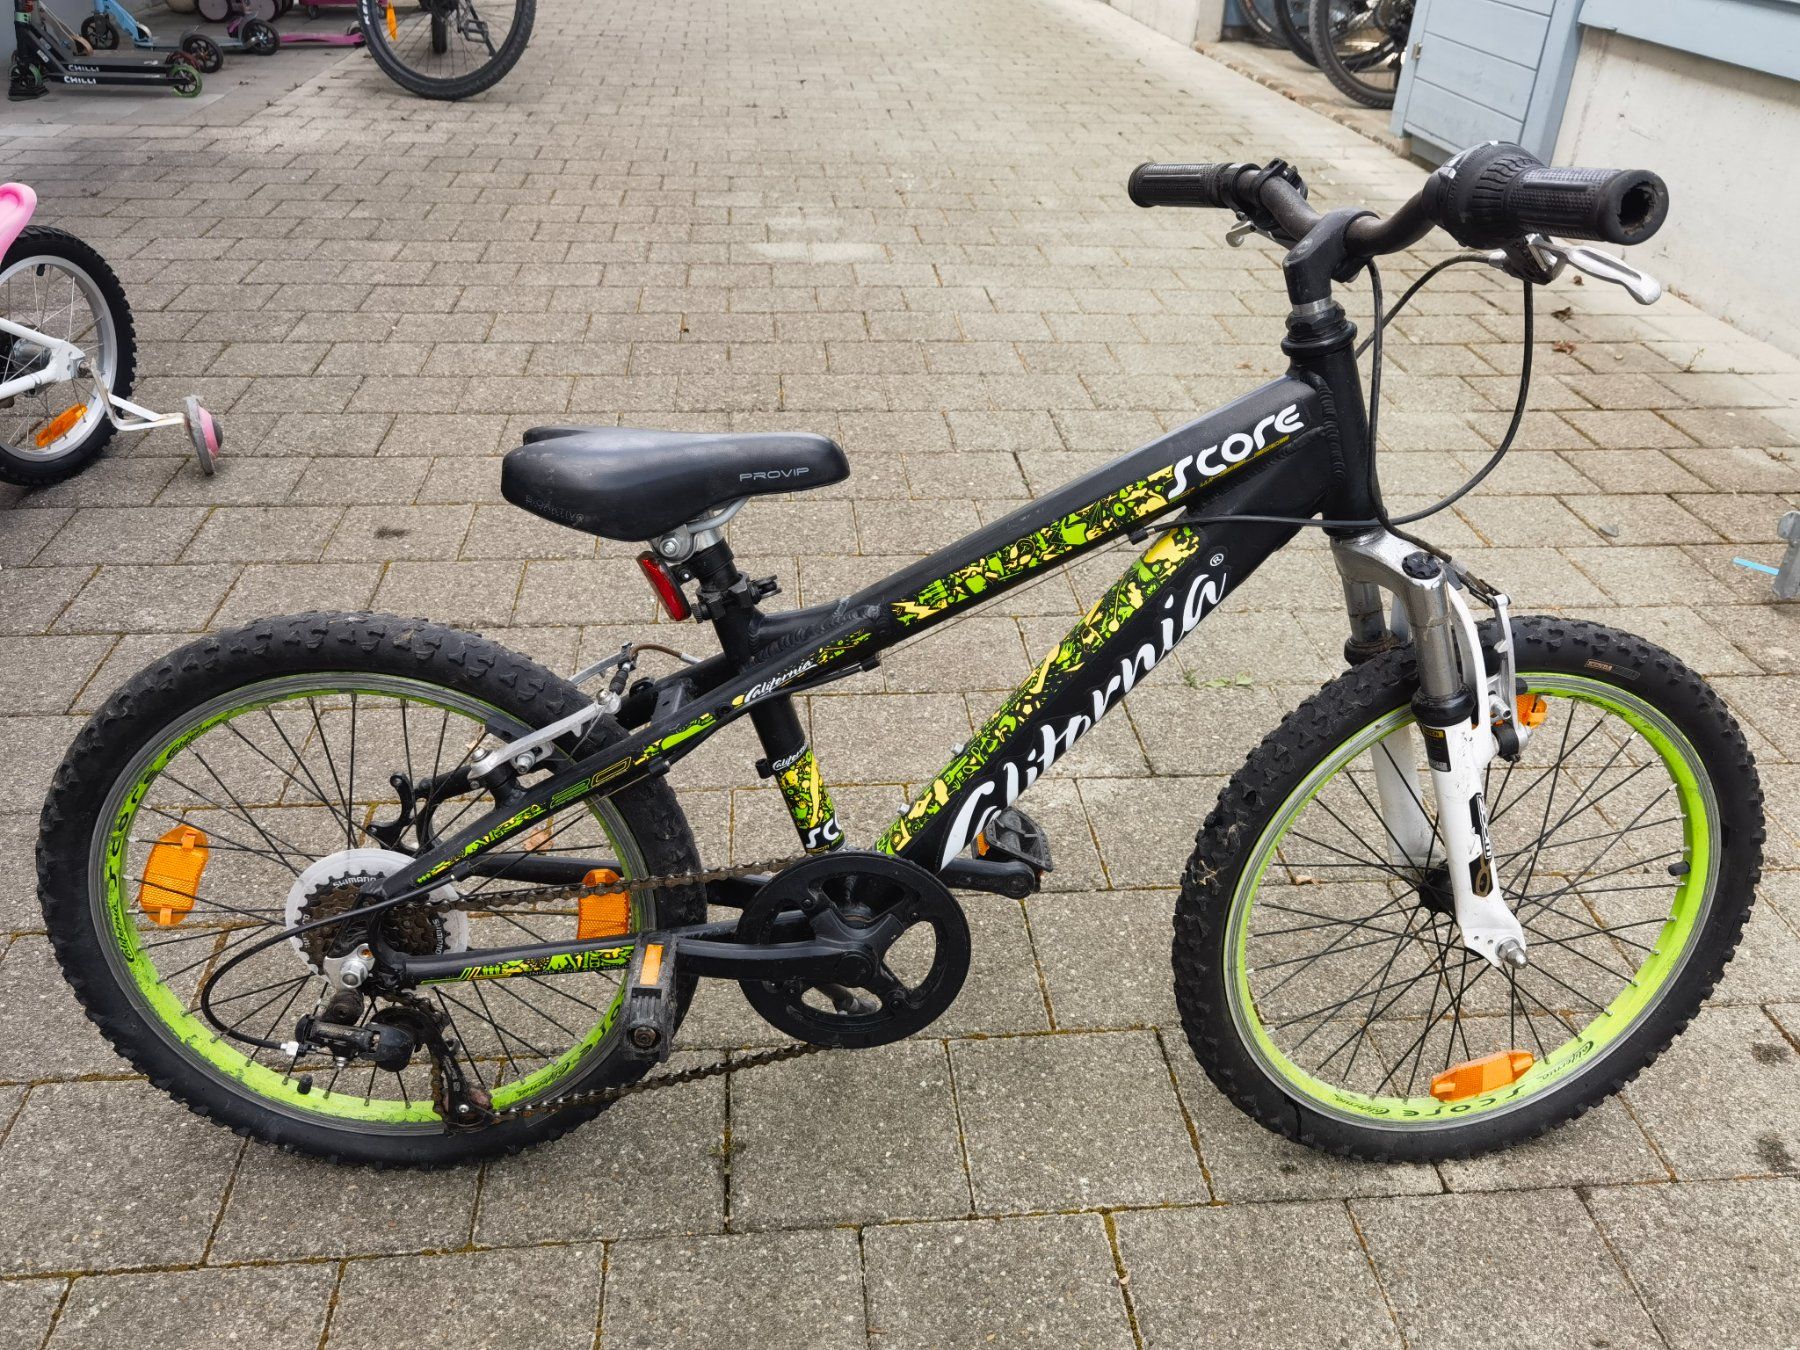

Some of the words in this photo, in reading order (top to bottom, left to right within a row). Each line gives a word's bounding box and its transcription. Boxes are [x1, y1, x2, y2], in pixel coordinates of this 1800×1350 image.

[68, 64, 100, 73] CHILLI
[63, 75, 97, 85] CHILLI
[739, 467, 809, 482] PROVIP
[744, 659, 818, 703] California
